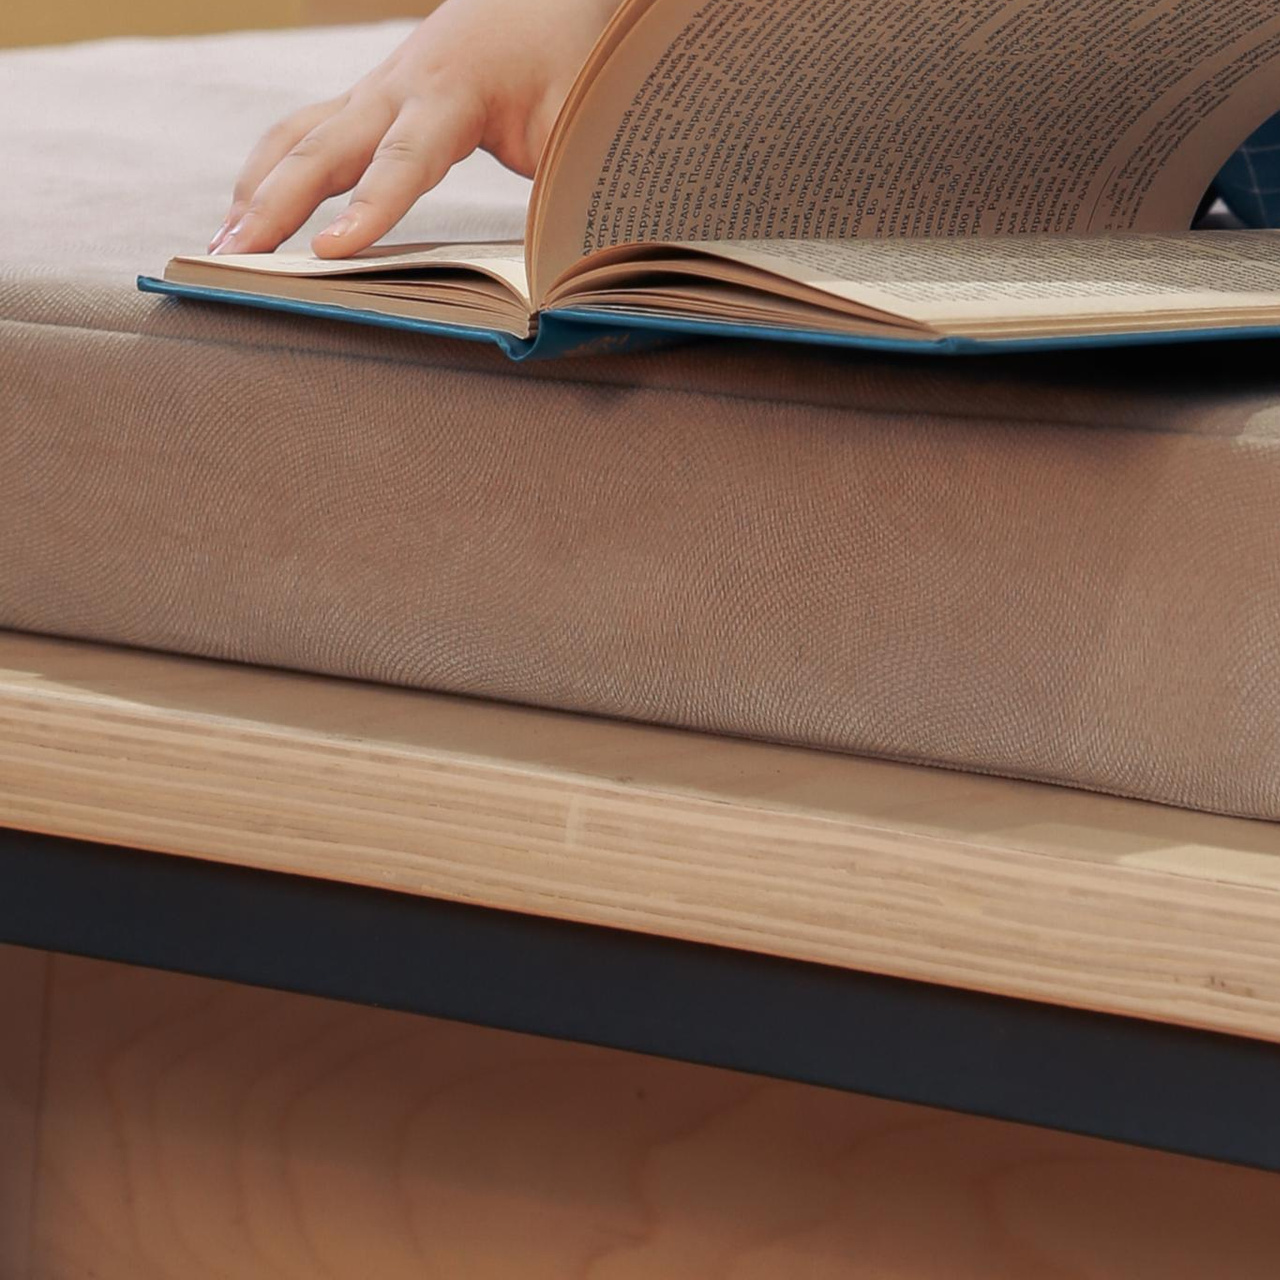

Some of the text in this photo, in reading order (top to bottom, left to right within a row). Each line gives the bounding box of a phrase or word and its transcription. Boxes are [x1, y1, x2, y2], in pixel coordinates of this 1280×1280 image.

[602, 109, 634, 172] взаимной
[631, 22, 696, 107] услужливостью.
[607, 123, 639, 197] пасмурной
[636, 81, 665, 121] погоде
[661, 51, 685, 80] рыба
[627, 147, 643, 176] дну,
[639, 107, 663, 141] когда
[660, 53, 699, 103] тяжелый
[658, 145, 684, 194] баклан
[680, 96, 710, 141] ныряет
[720, 53, 743, 75] дно,
[666, 117, 684, 140] как
[682, 71, 713, 113] щипцы
[687, 21, 797, 184] После завтрака благородный
[692, 184, 707, 219] свое
[704, 122, 734, 180] широкое
[739, 68, 771, 106] теплое
[768, 35, 799, 66] крыло
[704, 86, 730, 122] своим
[740, 149, 759, 184] жабо
[764, 72, 808, 130] торчащую
[806, 36, 841, 69] из-под
[776, 102, 812, 158] выстреле
[817, 40, 863, 89] покатится
[777, 116, 817, 188] сочинитель
[813, 54, 864, 114] похвальных
[786, 172, 801, 196] что
[797, 113, 833, 168] человеку
[829, 80, 856, 110] стоит
[853, 46, 886, 78] только
[795, 45, 901, 208] покровительством приютное
[830, 124, 864, 183] рукавице
[860, 74, 902, 123] охотника
[873, 79, 938, 169] род рыболовной
[908, 62, 941, 90] Китае
[633, 125, 666, 198] погружает
[671, 65, 703, 108] мутные
[713, 140, 738, 189] костей
[721, 110, 769, 209] неподвижного,
[746, 142, 777, 197] баклана
[777, 75, 820, 131] красными
[812, 147, 838, 196] сделать
[832, 99, 868, 145] баклана
[865, 80, 884, 98] для
[833, 167, 854, 199] Если
[850, 122, 878, 164] верить
[876, 160, 895, 189] всех
[894, 86, 944, 154] рыболовных
[885, 124, 927, 199] приморских
[932, 76, 966, 112] речных
[903, 120, 945, 184] заведений,
[927, 125, 966, 183] кармаков,
[964, 101, 984, 120] или
[950, 123, 980, 160] (самая
[960, 133, 985, 166] лодок
[982, 95, 1015, 131] разной
[971, 143, 1003, 195] рыбаков
[987, 104, 1061, 212] Рыболовный завод
[1005, 151, 1035, 200] магазин
[1006, 211, 1018, 234] для
[1014, 183, 1029, 207] них
[1058, 102, 1089, 131] амбар
[1084, 86, 1103, 101] для
[1030, 172, 1061, 233] приборы,
[1083, 114, 1102, 131] для
[1066, 152, 1083, 172] для
[971, 163, 1003, 237] требляется
[1018, 176, 1044, 235] роенные
[1047, 138, 1070, 162] виде
[1065, 138, 1119, 232] того для зимних
